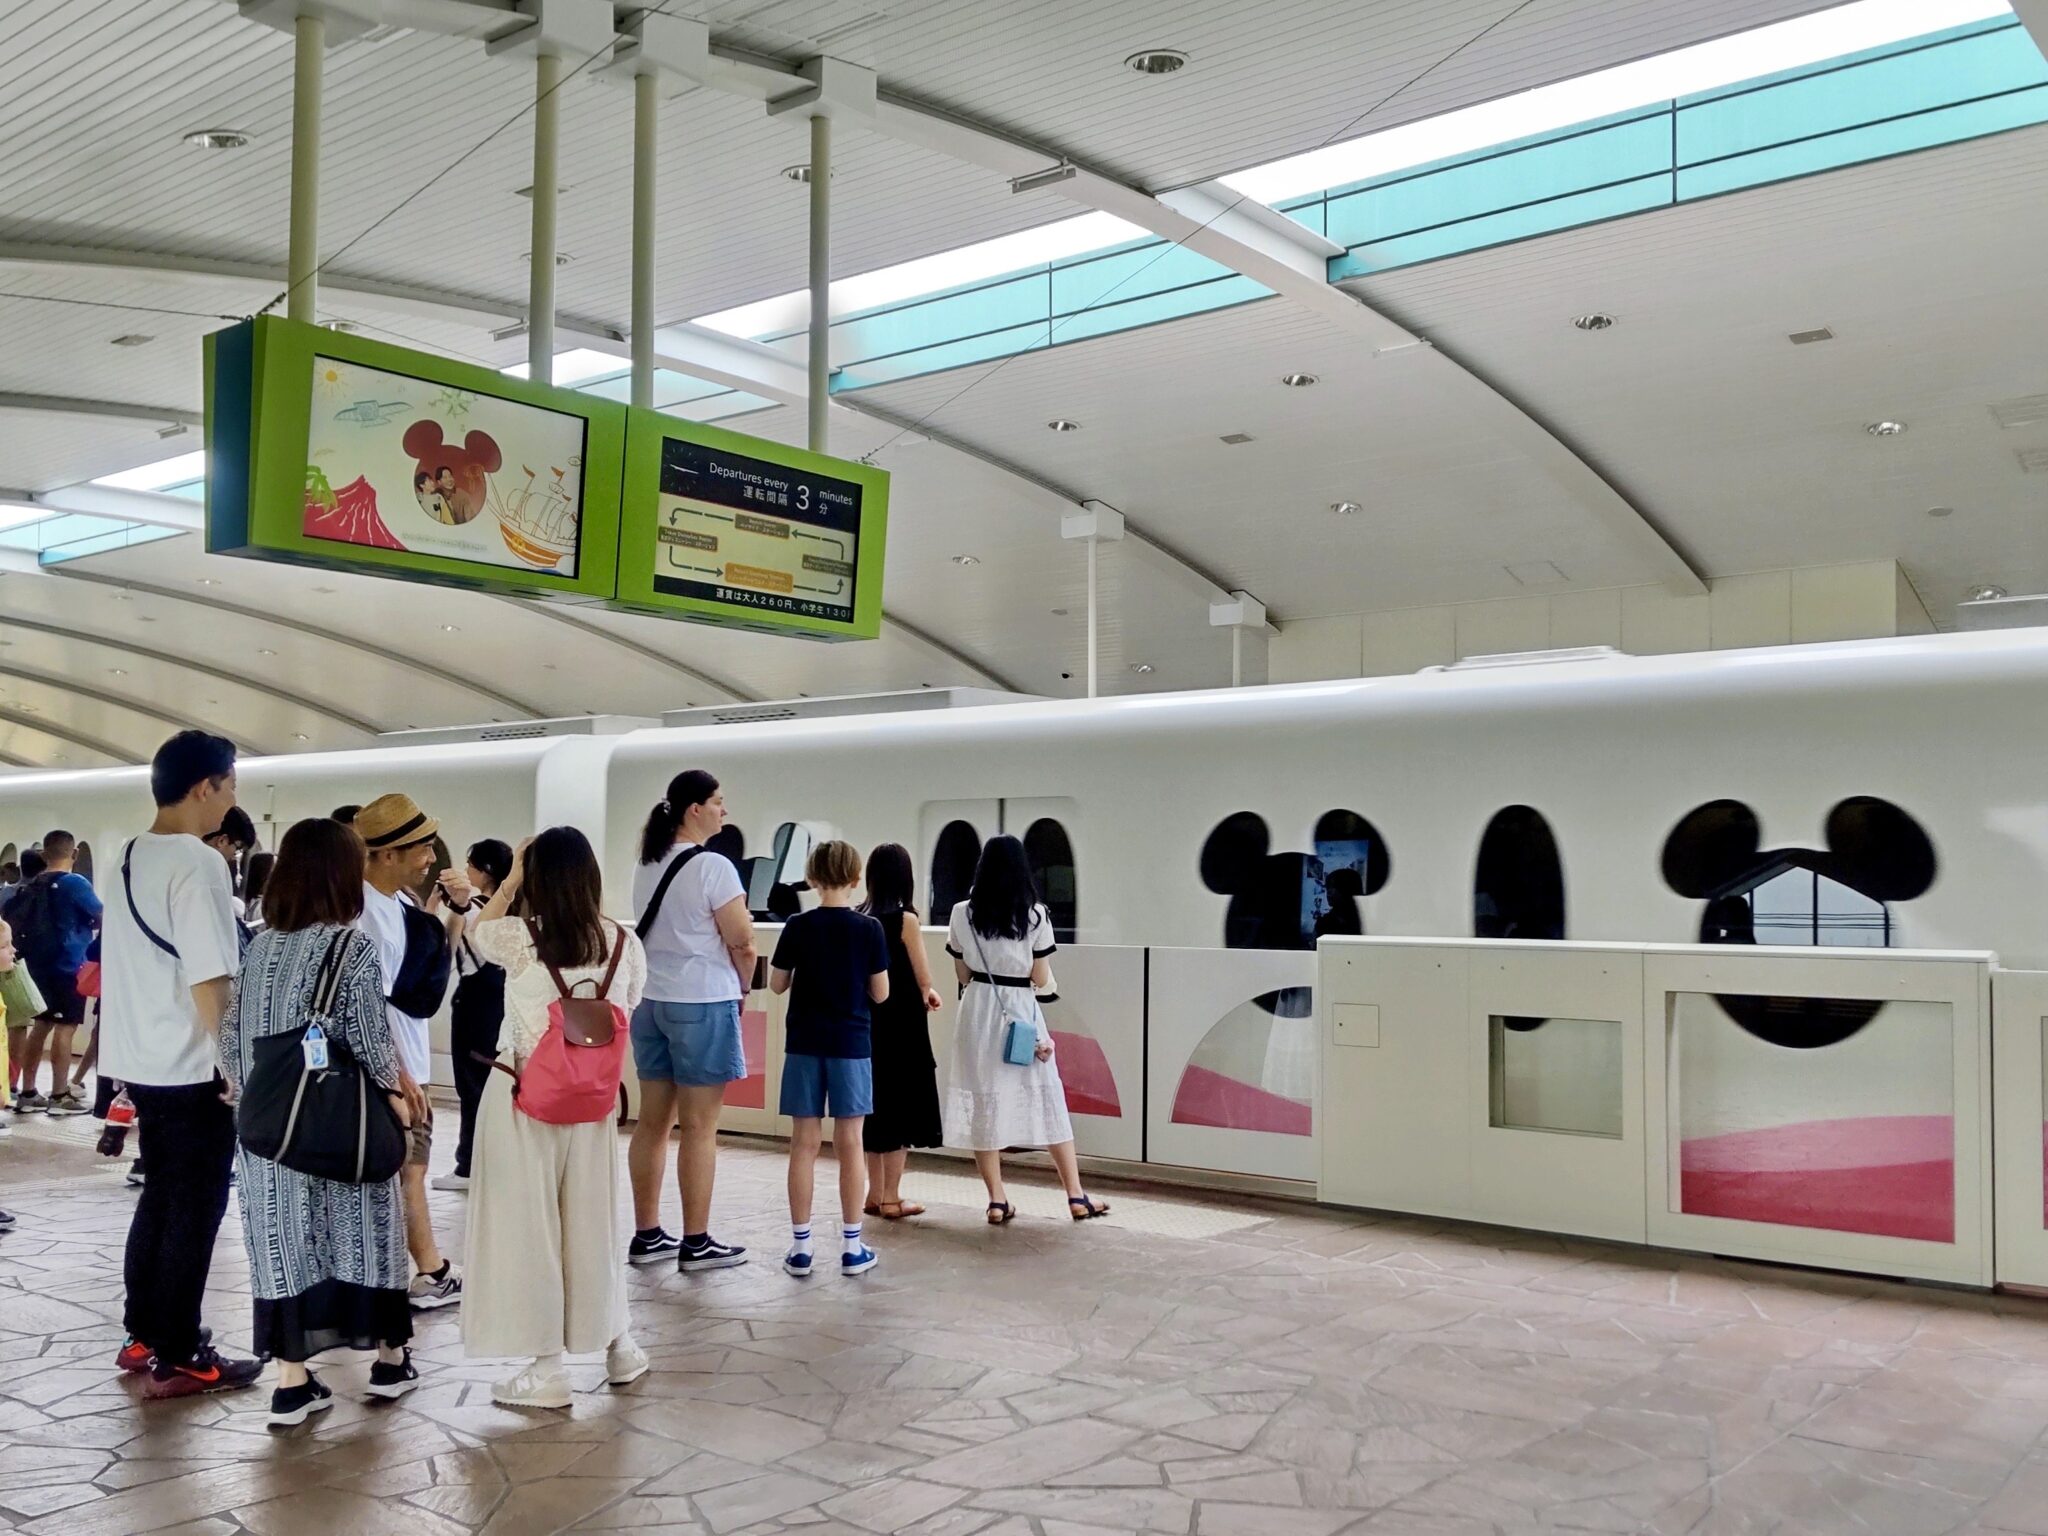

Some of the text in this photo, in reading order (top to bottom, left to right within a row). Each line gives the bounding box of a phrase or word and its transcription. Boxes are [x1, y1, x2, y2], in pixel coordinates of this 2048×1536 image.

[709, 462, 853, 510] Departures every 3 minutes
[743, 485, 828, 515] 運転間隔 分
